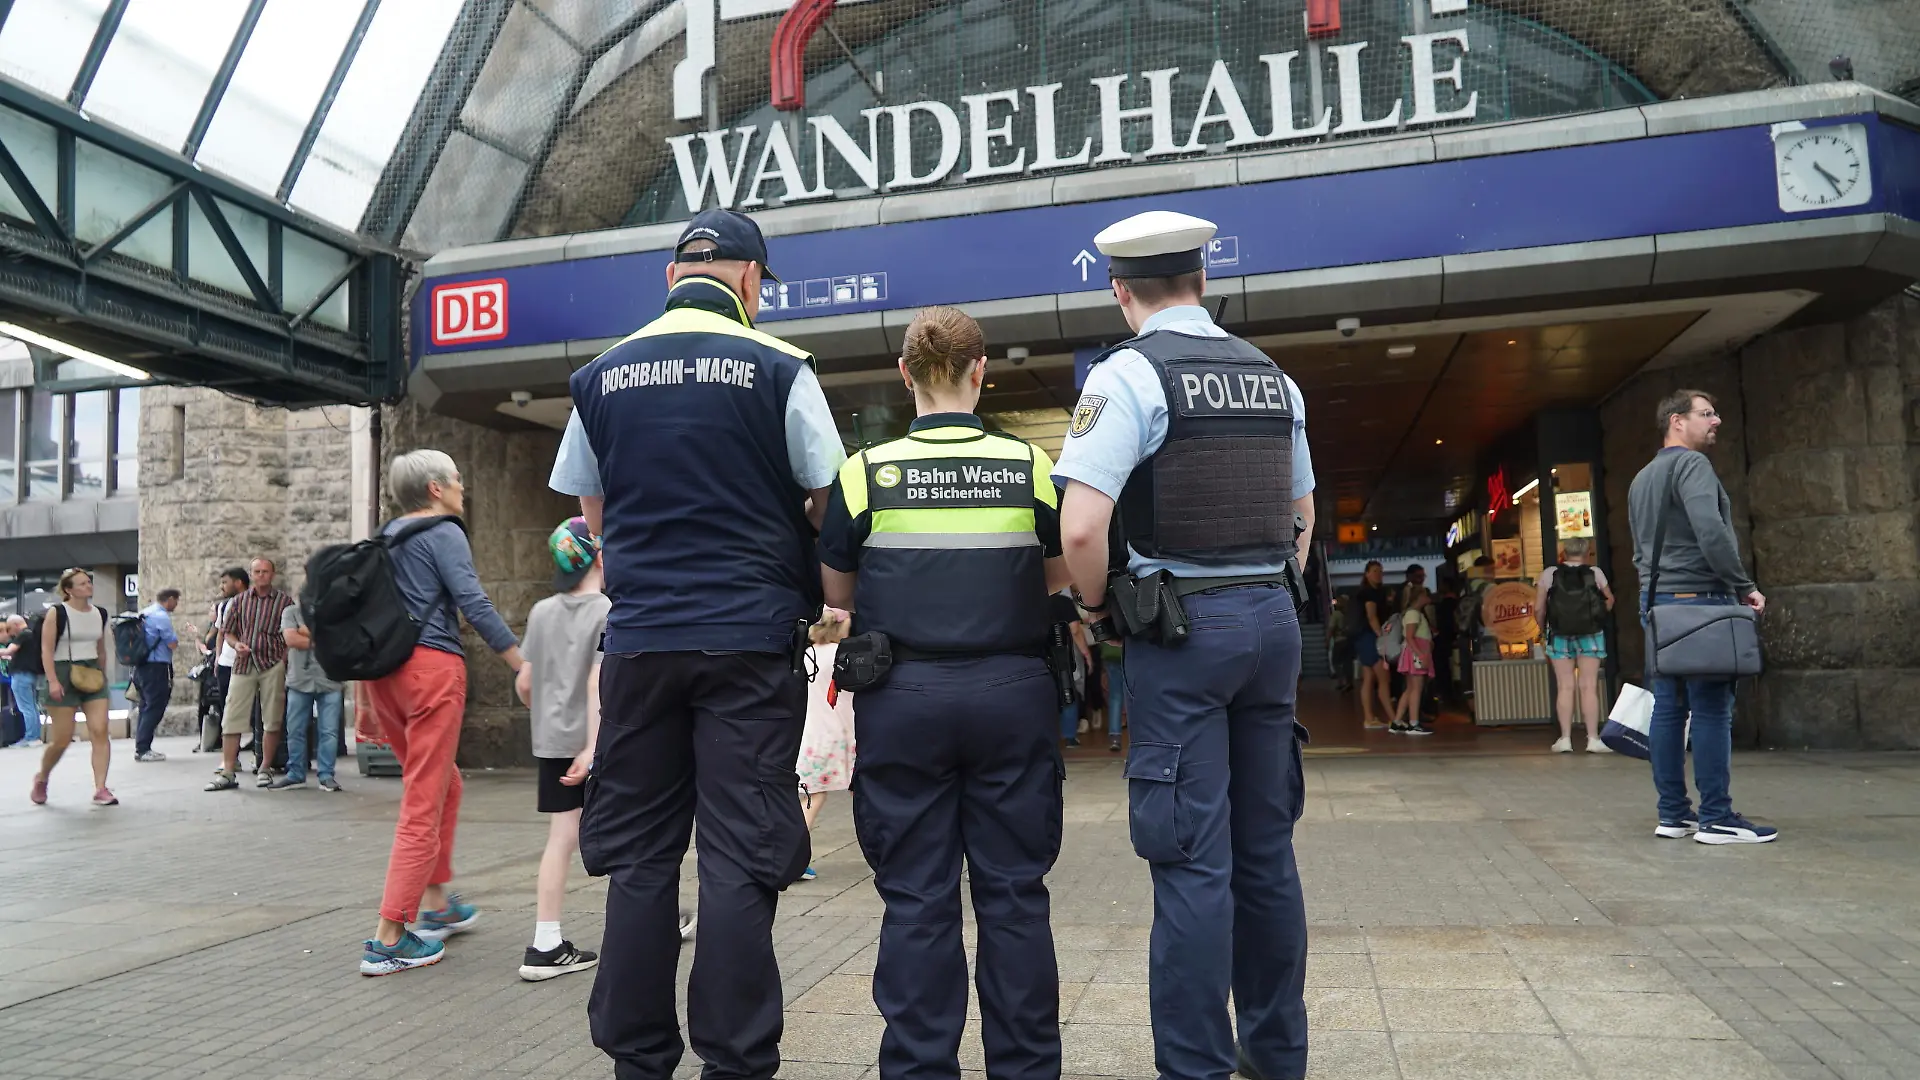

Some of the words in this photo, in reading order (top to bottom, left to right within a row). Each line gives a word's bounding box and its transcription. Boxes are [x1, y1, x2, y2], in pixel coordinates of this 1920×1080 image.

[665, 28, 1478, 213] WANDELHALLE
[442, 291, 499, 335] DB
[601, 357, 756, 396] HOCHBAHN-WACHE
[1180, 372, 1288, 410] POLIZEI
[879, 466, 897, 486] S
[906, 468, 958, 485] Bahn
[961, 465, 1027, 485] Wache
[907, 487, 928, 500] DB
[930, 486, 1002, 499] Sicherheit
[1495, 602, 1533, 620] Ditsch
